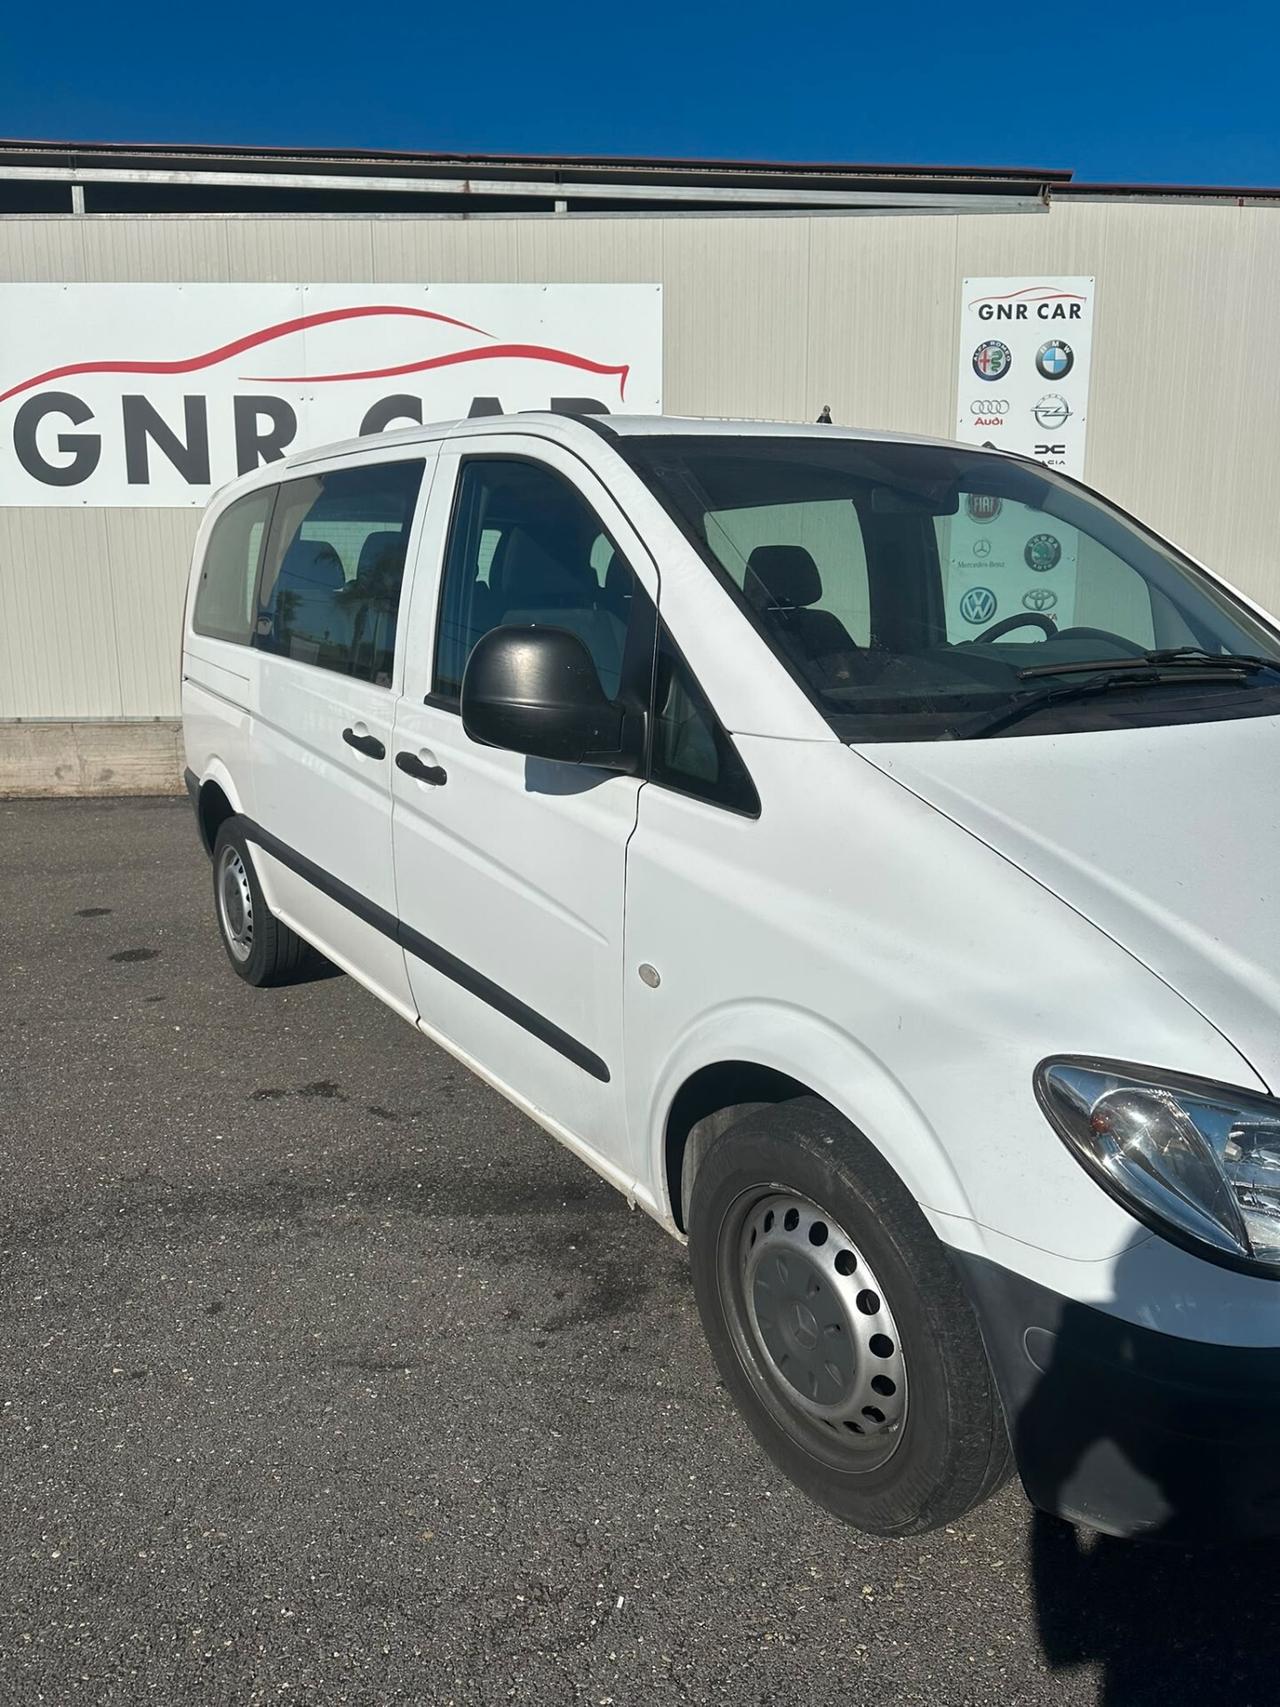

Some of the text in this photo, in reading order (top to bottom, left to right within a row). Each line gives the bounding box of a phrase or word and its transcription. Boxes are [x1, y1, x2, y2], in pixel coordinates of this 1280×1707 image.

[978, 303, 1082, 320] GNR CAR
[990, 341, 1011, 362] ROMEO
[1039, 341, 1071, 354] BMW
[974, 416, 1003, 426] Audi
[13, 391, 298, 487] GNR
